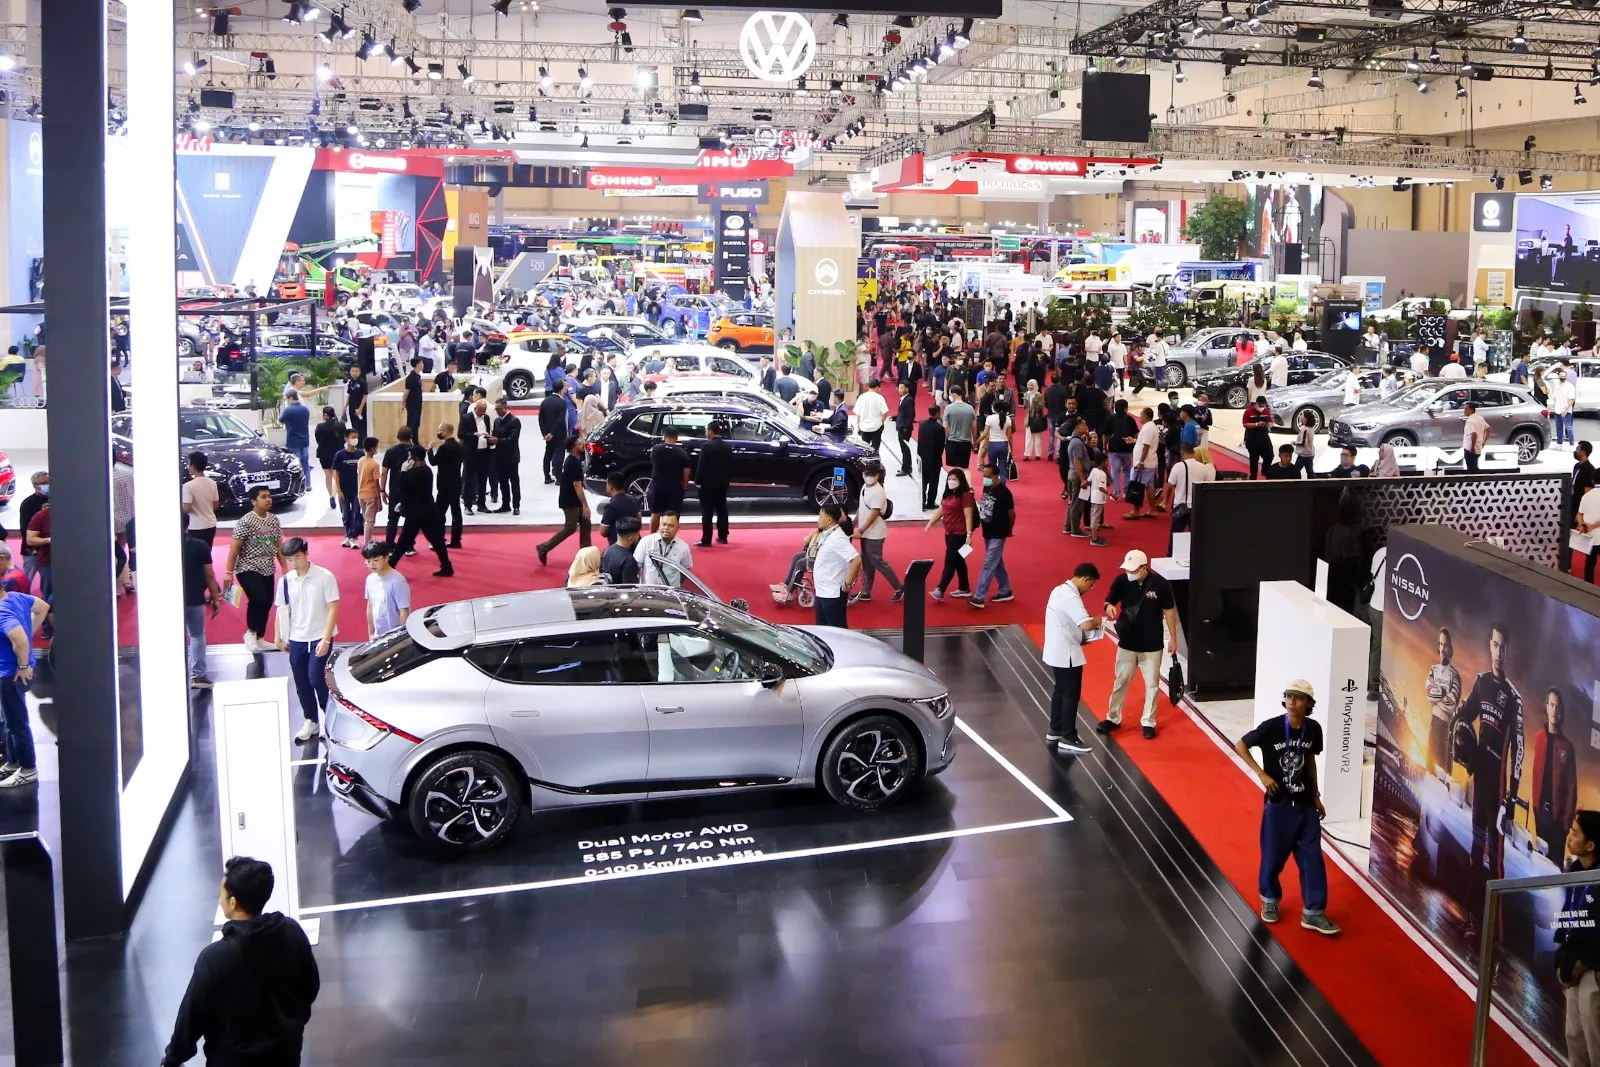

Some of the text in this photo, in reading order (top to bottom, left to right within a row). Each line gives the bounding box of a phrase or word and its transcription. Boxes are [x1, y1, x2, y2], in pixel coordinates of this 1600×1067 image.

[697, 155, 750, 168] INO
[1033, 161, 1078, 172] TOYOTA
[607, 176, 654, 187] HINO
[1000, 180, 1041, 190] TRUCKS
[720, 187, 763, 198] FUSO
[1391, 573, 1430, 601] NISSAN
[1481, 703, 1503, 720] NISSAN
[1340, 696, 1354, 773] PlayStation VR2
[577, 823, 749, 850] Dual Motor AWD
[582, 851, 624, 863] 585
[628, 848, 654, 858] Ps
[673, 840, 714, 853] 740
[719, 835, 756, 847] Nm
[584, 863, 640, 877] 0-100
[1554, 909, 1588, 919] PLEASE DO NOT
[1550, 920, 1596, 929] LEAN ON THE GLASS
